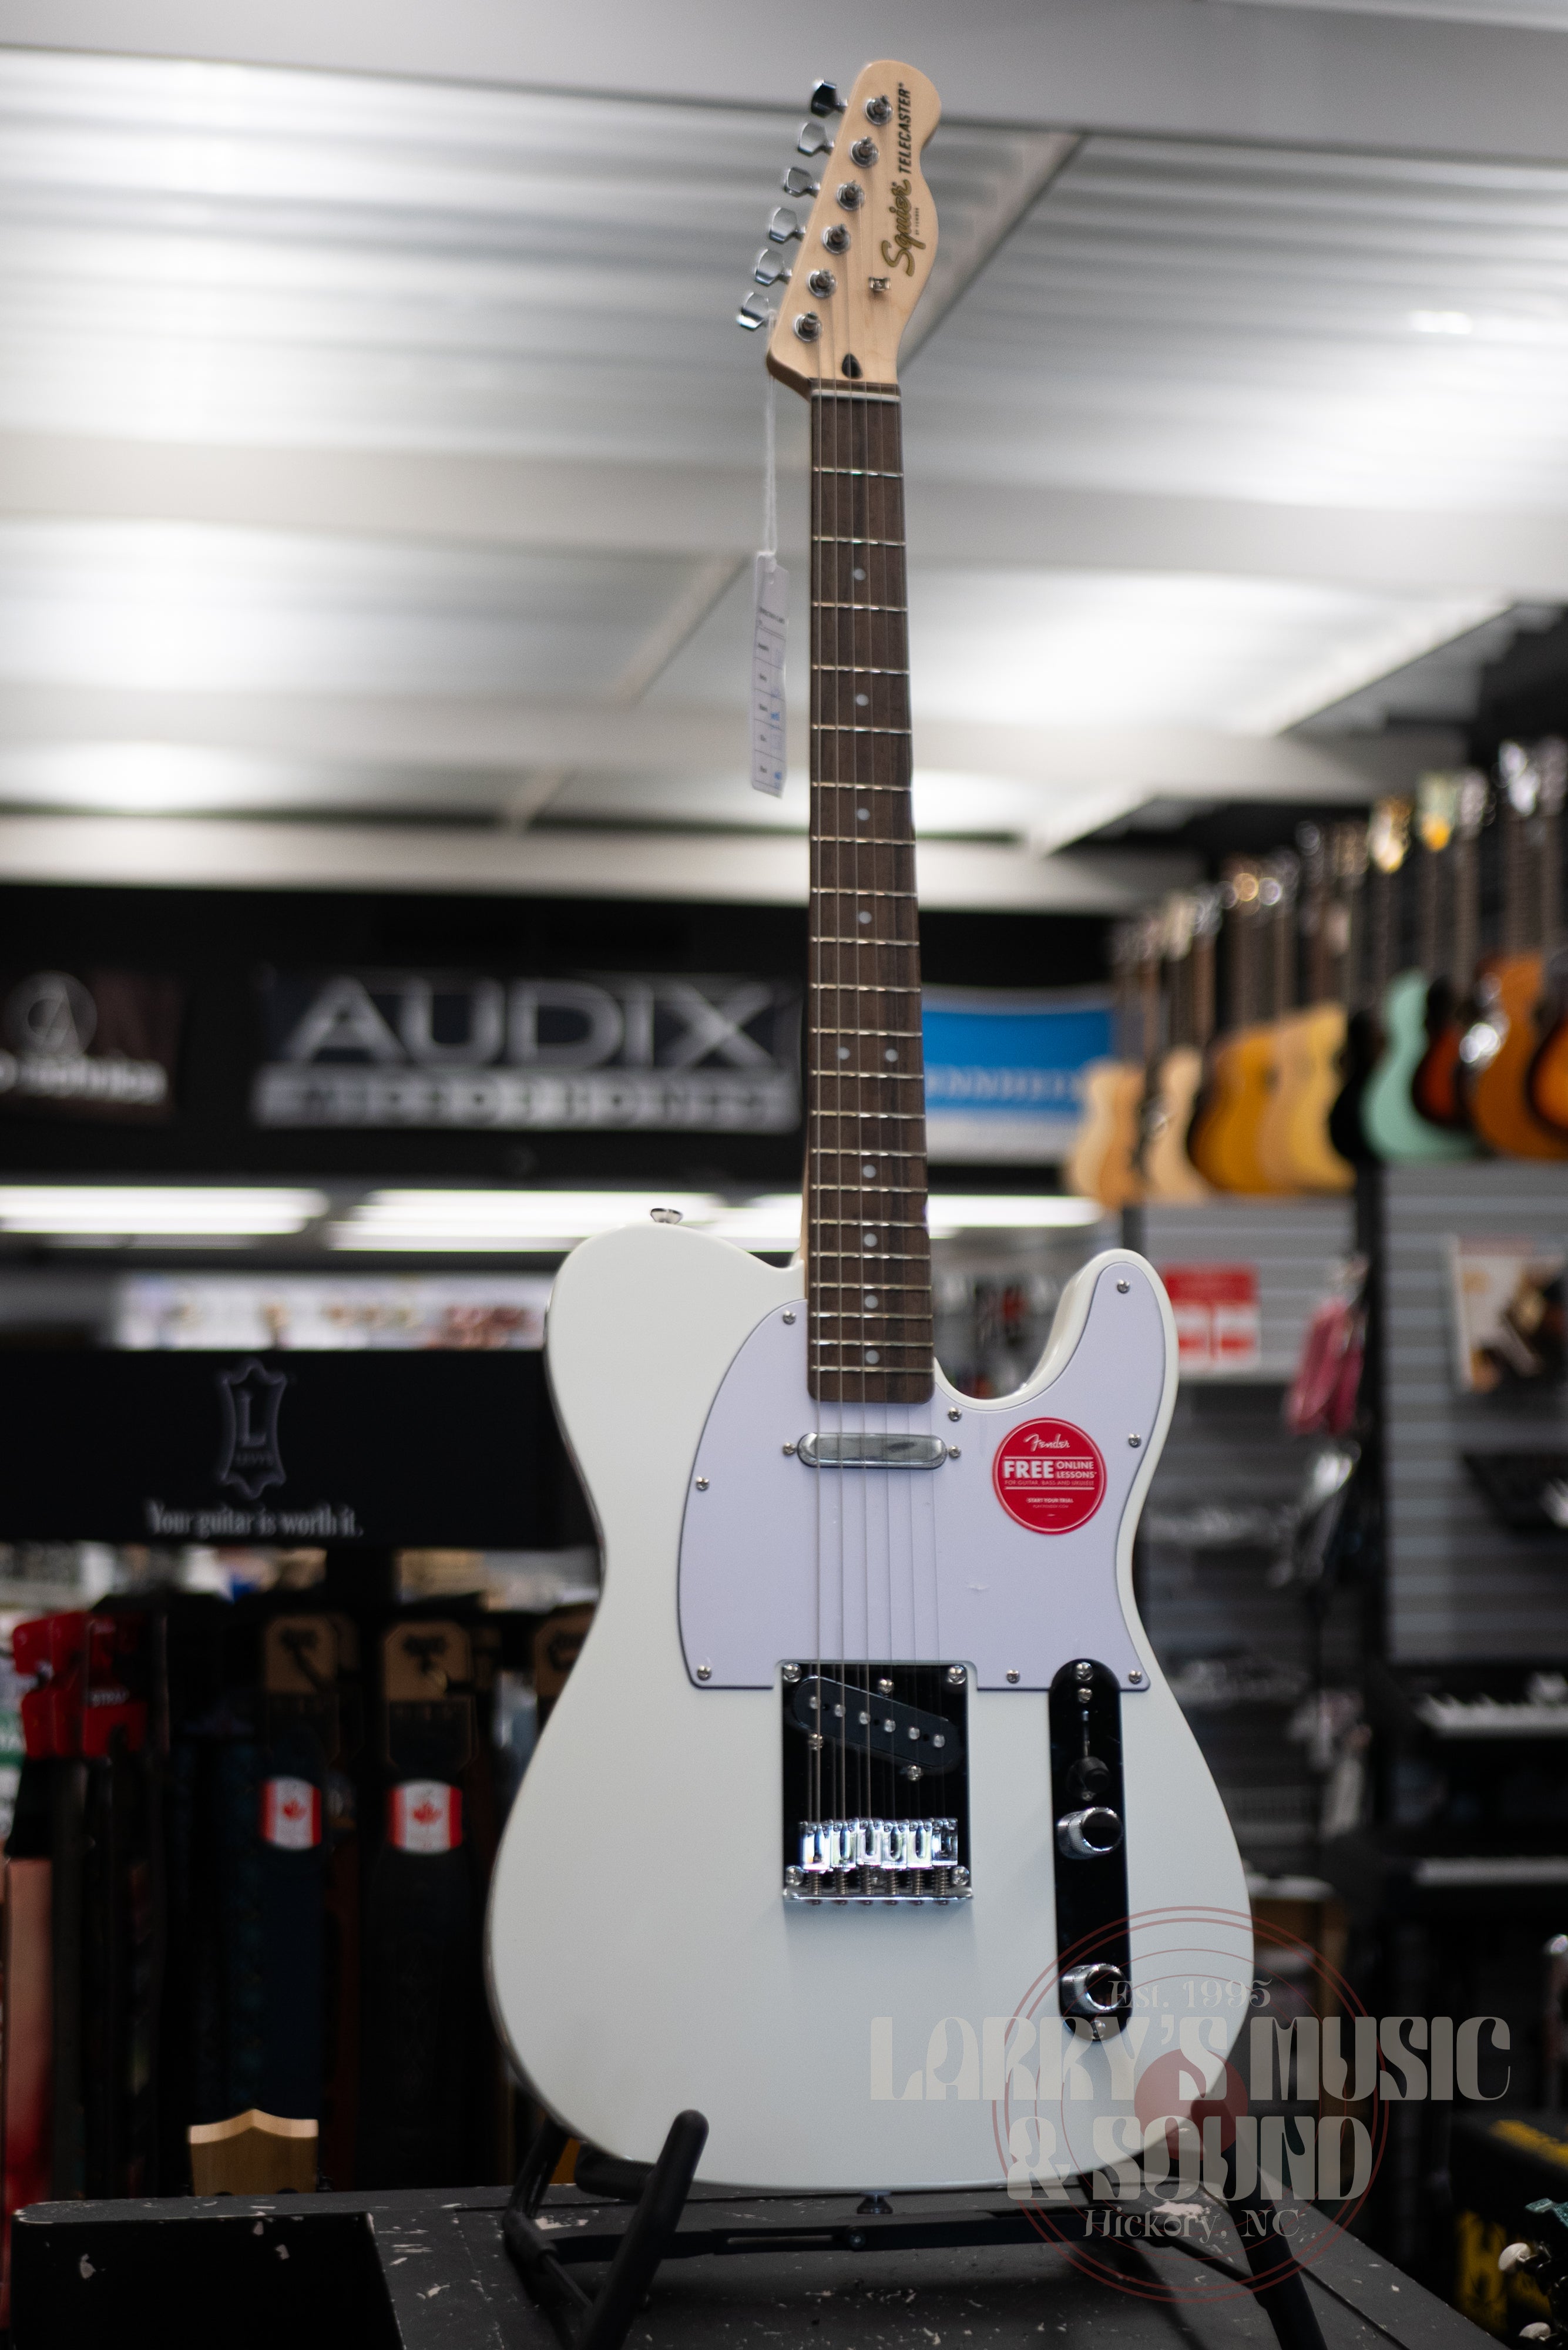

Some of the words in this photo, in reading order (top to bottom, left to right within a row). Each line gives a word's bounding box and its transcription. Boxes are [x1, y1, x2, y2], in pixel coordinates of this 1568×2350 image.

[898, 86, 912, 174] TELECASTER
[881, 179, 926, 277] Squier
[280, 975, 778, 1066] AUDIX
[1023, 1433, 1070, 1452] Fender
[1003, 1461, 1054, 1479] FREE
[1056, 1461, 1094, 1469] ONLINE
[144, 1498, 191, 1536] Your
[192, 1502, 252, 1539] guitar
[254, 1502, 277, 1537] is
[279, 1499, 337, 1537] worth
